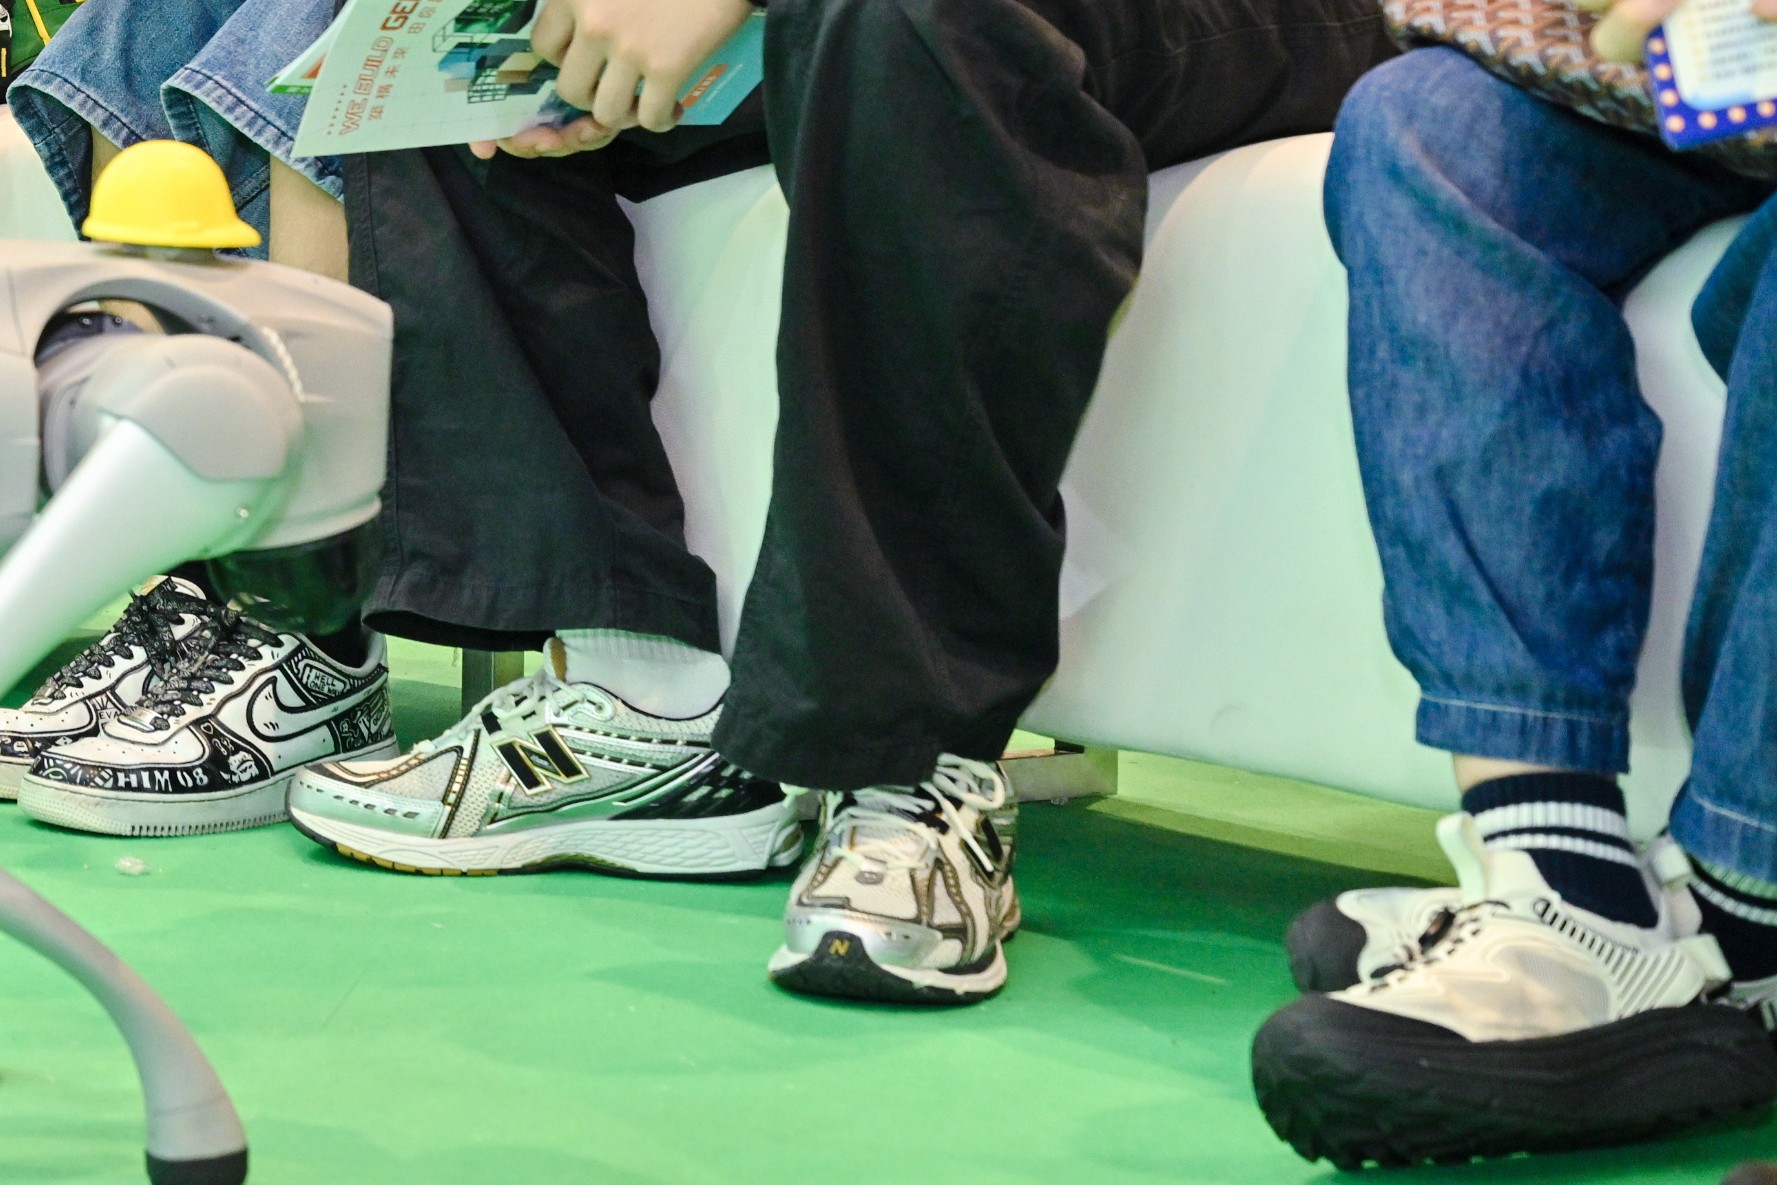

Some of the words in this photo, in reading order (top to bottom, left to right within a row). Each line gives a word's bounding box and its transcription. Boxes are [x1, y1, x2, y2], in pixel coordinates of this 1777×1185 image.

[353, 35, 394, 96] BUILD
[339, 97, 368, 136] WE
[490, 724, 591, 796] N
[828, 938, 851, 956] N
